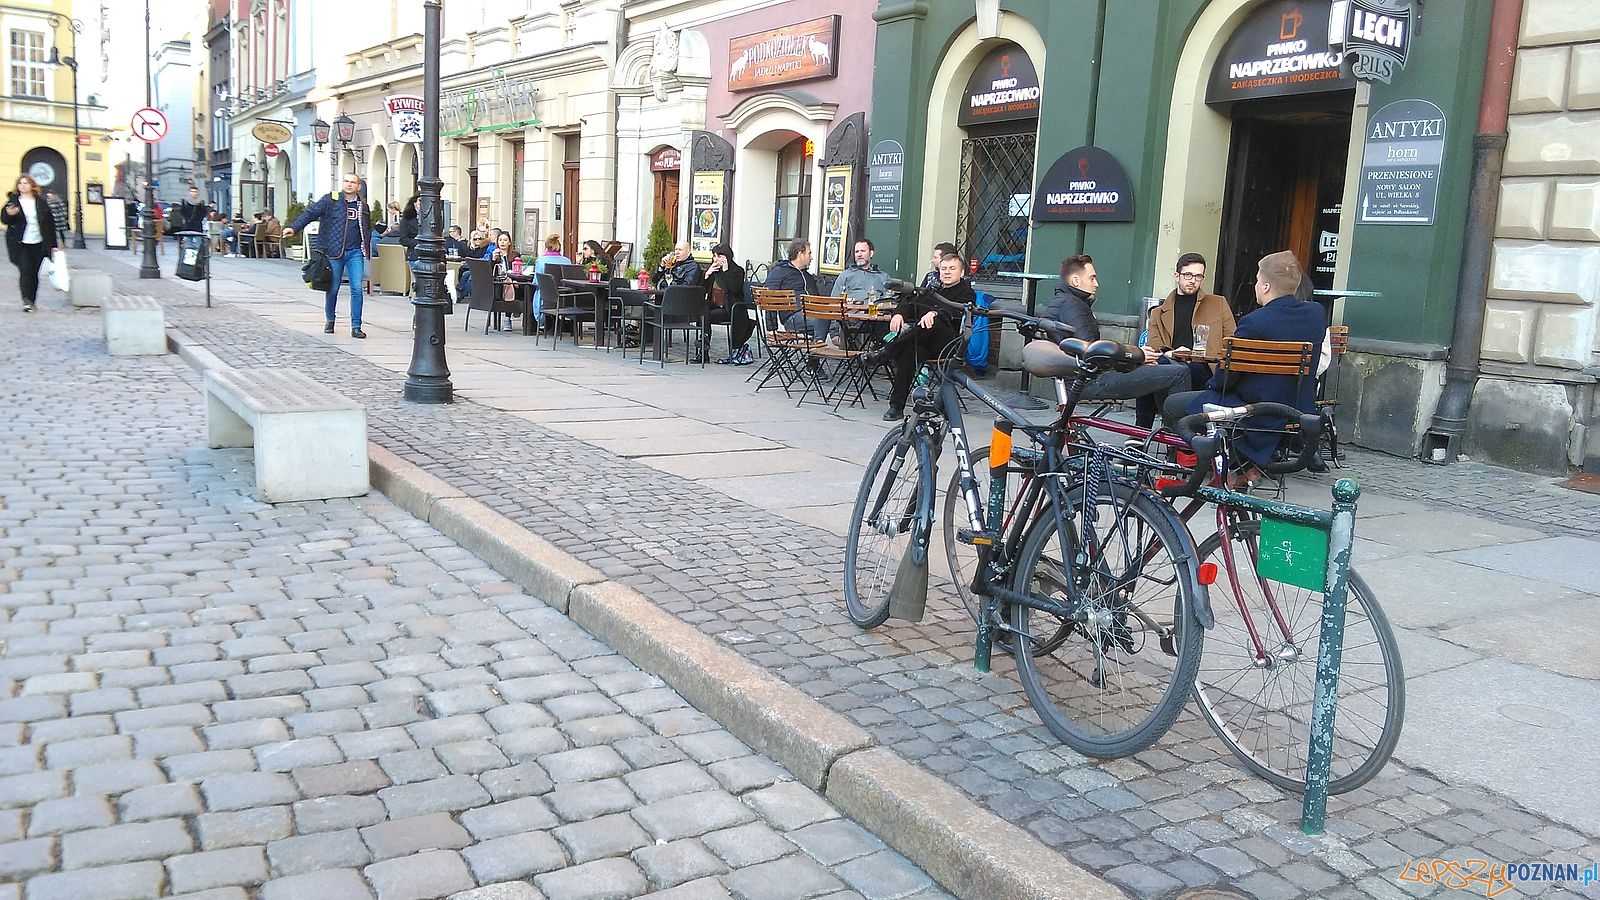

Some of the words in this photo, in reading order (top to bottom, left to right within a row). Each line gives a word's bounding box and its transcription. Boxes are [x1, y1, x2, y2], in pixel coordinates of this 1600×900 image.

[1352, 8, 1403, 48] LECH
[1267, 40, 1306, 57] PIWKO
[1230, 53, 1343, 79] NAPRZECIWKO
[1359, 54, 1393, 77] PILS
[991, 78, 1018, 91] PIWKO
[970, 86, 1040, 108] NAPRZECIWKO
[1370, 119, 1442, 139] ANTYKI
[872, 153, 902, 165] ANTYKI
[1387, 145, 1418, 158] horn
[1367, 170, 1434, 180] PRZENIESIONE
[1069, 181, 1096, 191] PIWKO
[1046, 192, 1119, 205] NAPRZECIWKO
